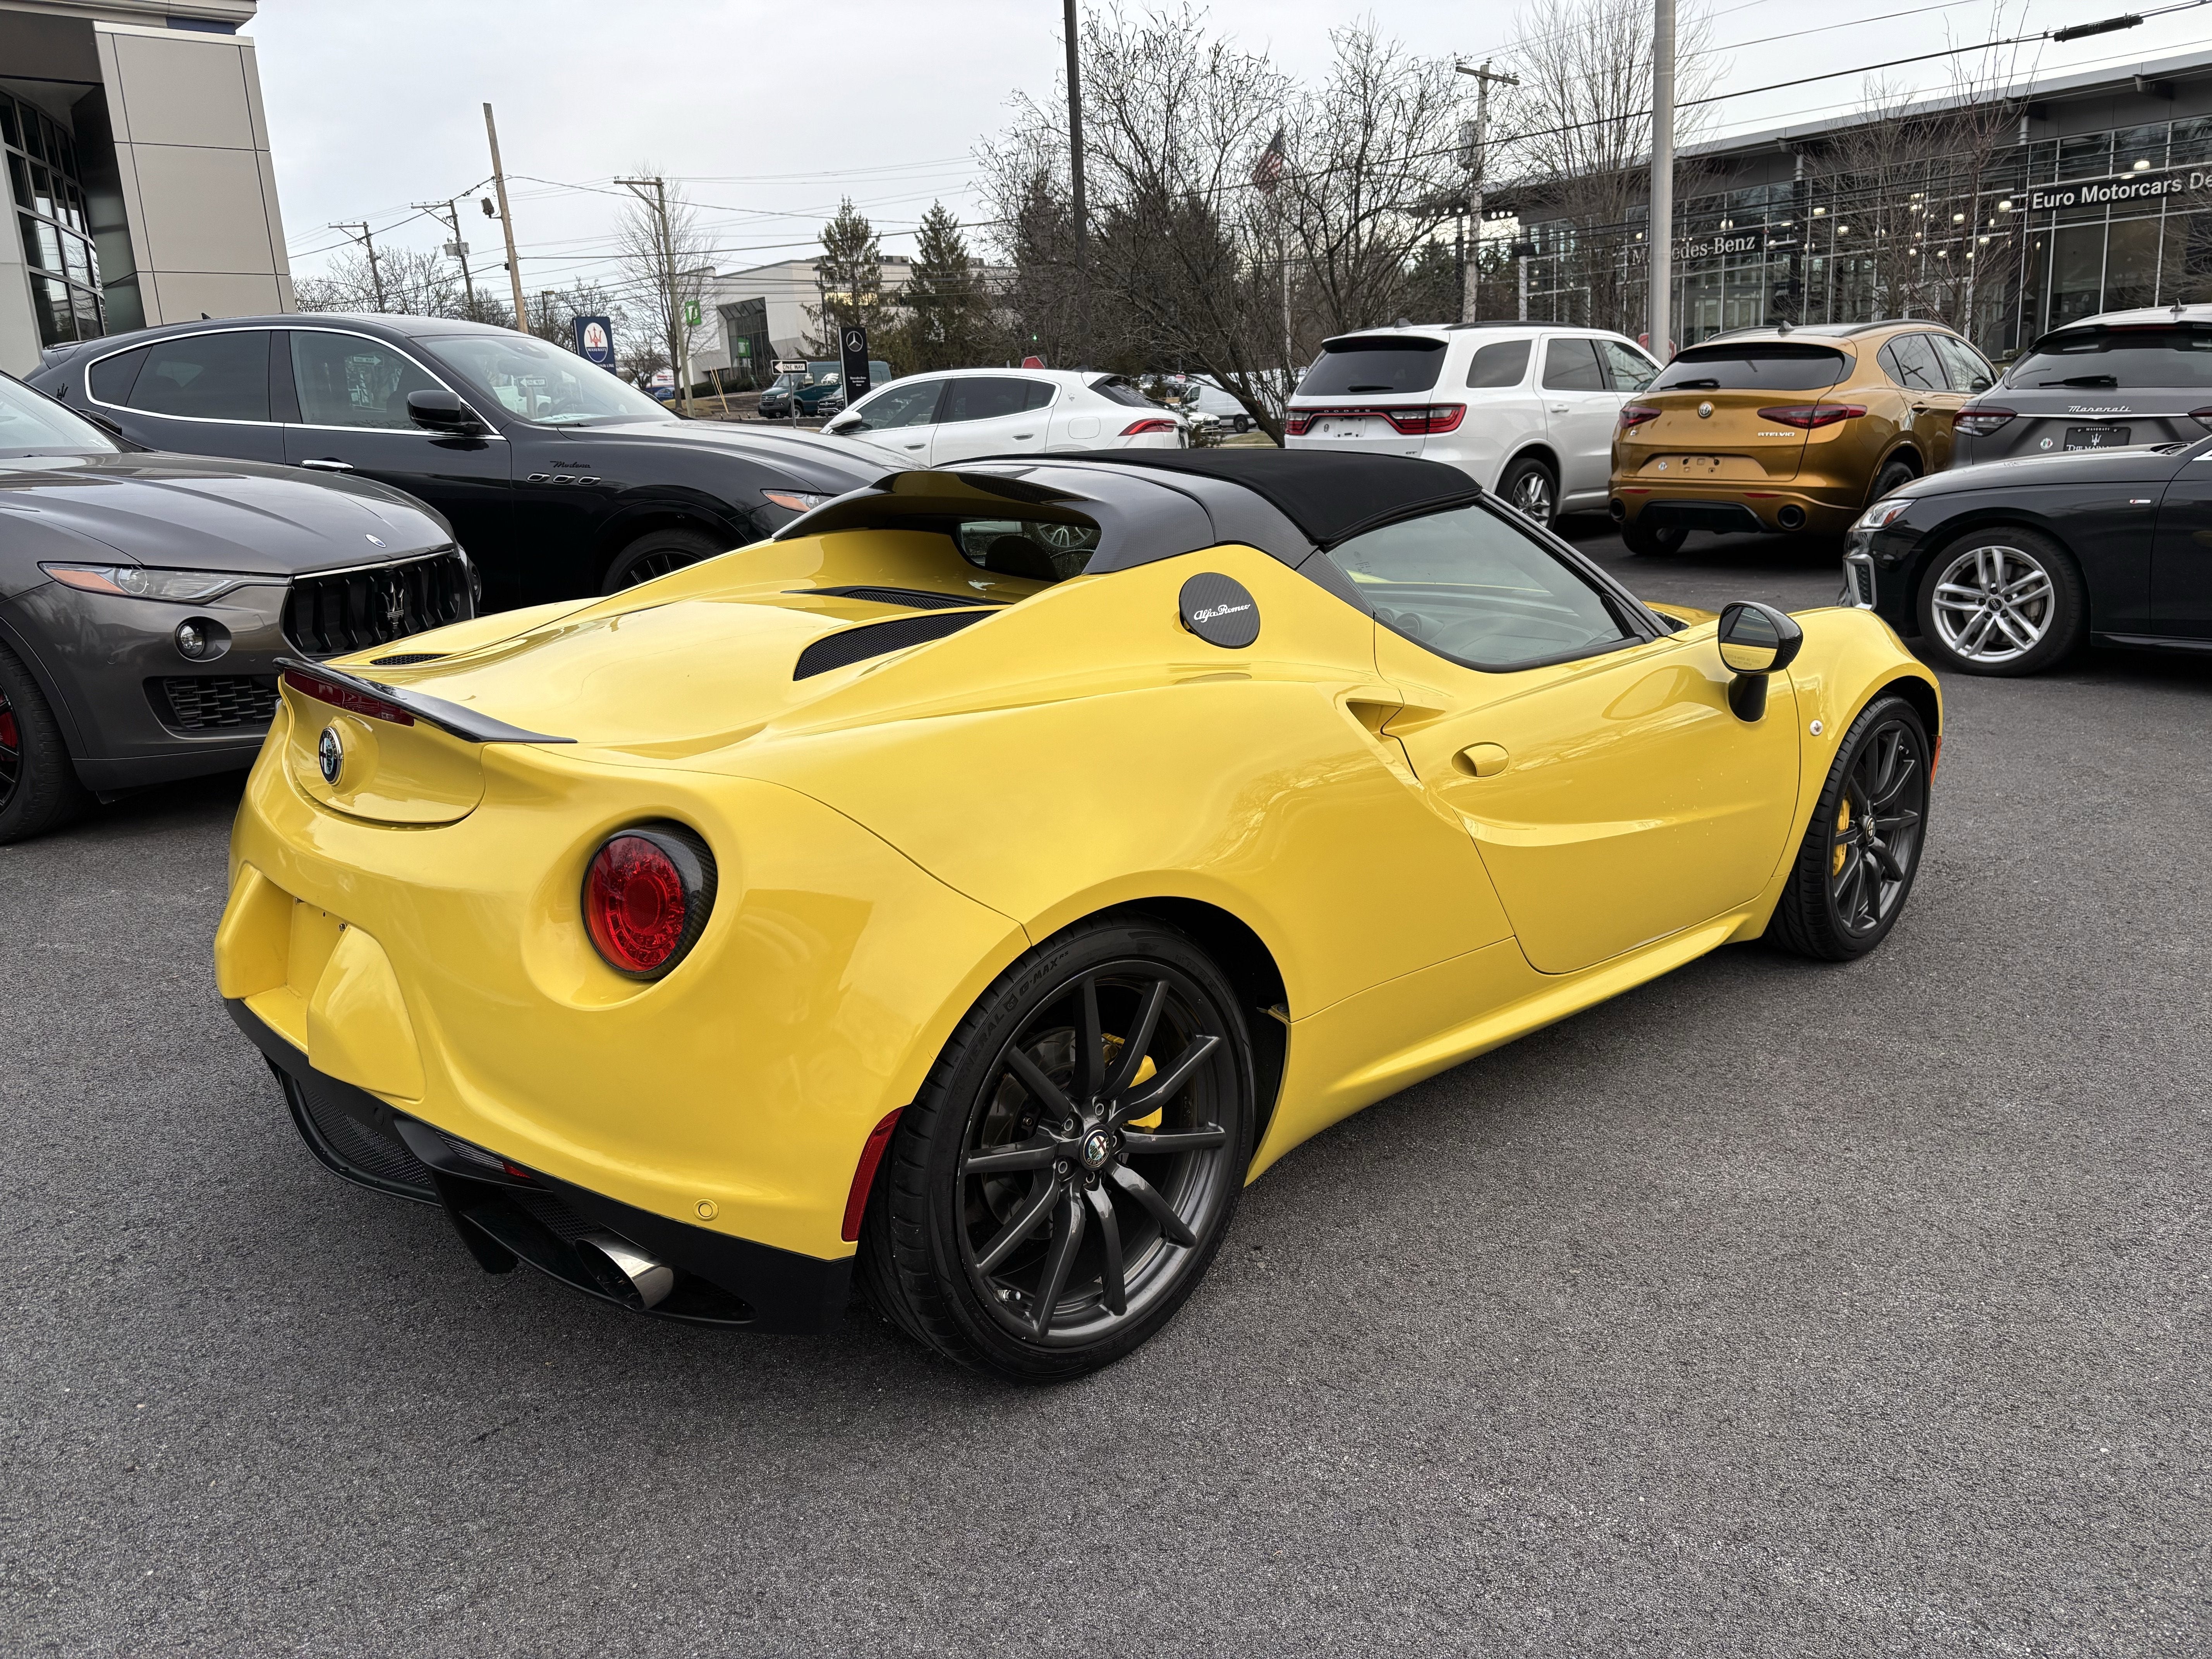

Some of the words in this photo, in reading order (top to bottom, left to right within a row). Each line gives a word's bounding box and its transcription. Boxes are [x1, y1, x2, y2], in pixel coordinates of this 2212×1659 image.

[2032, 192, 2075, 210] Euro
[2081, 178, 2182, 204] Motorcars
[1631, 236, 1756, 266] Medes-Benz
[1194, 608, 1219, 623] Alfa
[1218, 604, 1251, 614] Romeo
[1060, 950, 1070, 960] RS
